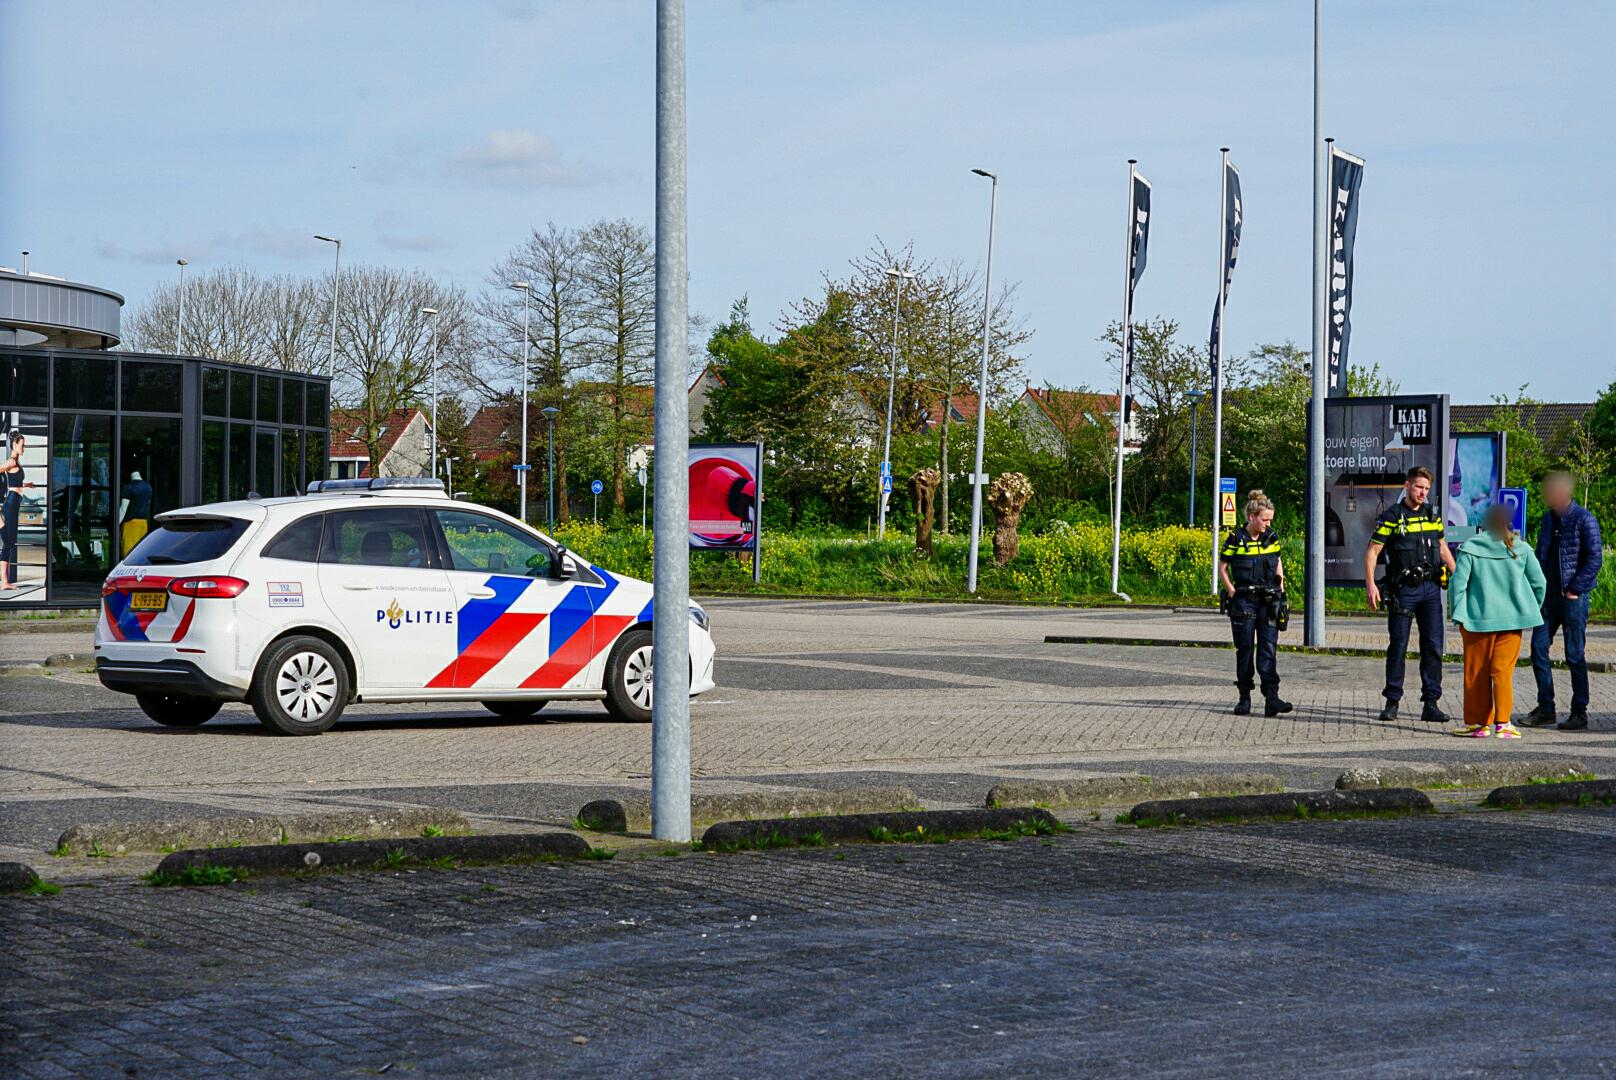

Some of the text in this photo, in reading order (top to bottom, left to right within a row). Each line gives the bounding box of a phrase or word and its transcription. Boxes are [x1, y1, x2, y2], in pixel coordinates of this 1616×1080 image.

[1397, 409, 1427, 423] KAR
[1402, 423, 1427, 438] WEI
[1325, 434, 1380, 452] ouw eigen
[1324, 453, 1387, 471] toere lamp
[133, 595, 163, 607] L-193-BS
[376, 609, 453, 629] POLITIE
